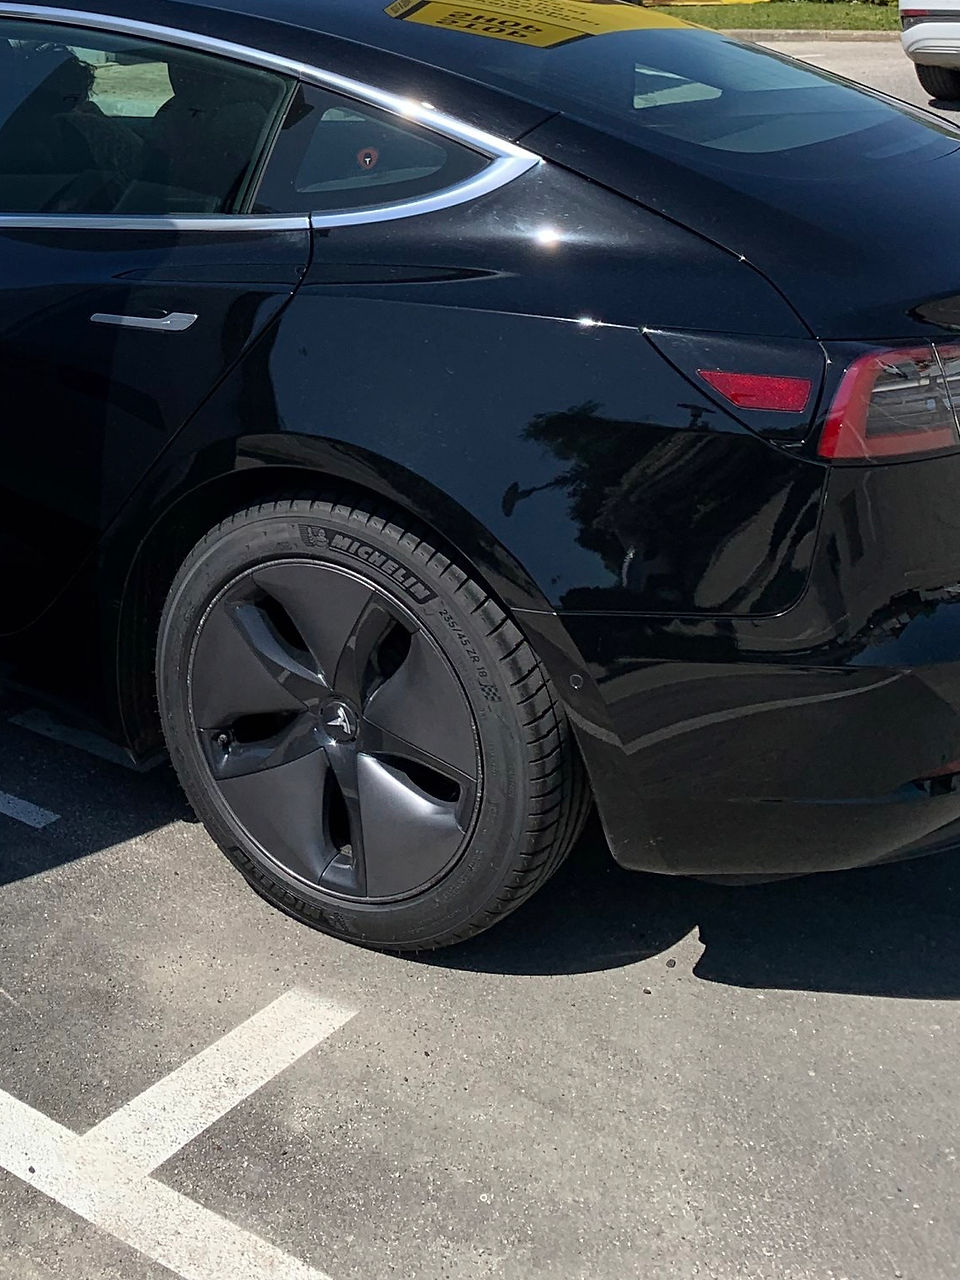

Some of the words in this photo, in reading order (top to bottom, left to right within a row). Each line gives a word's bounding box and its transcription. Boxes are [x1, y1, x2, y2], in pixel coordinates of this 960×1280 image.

[330, 534, 431, 601] MICHELIN
[439, 609, 470, 647] 235/45
[466, 649, 480, 663] ZR
[477, 667, 488, 679] 18
